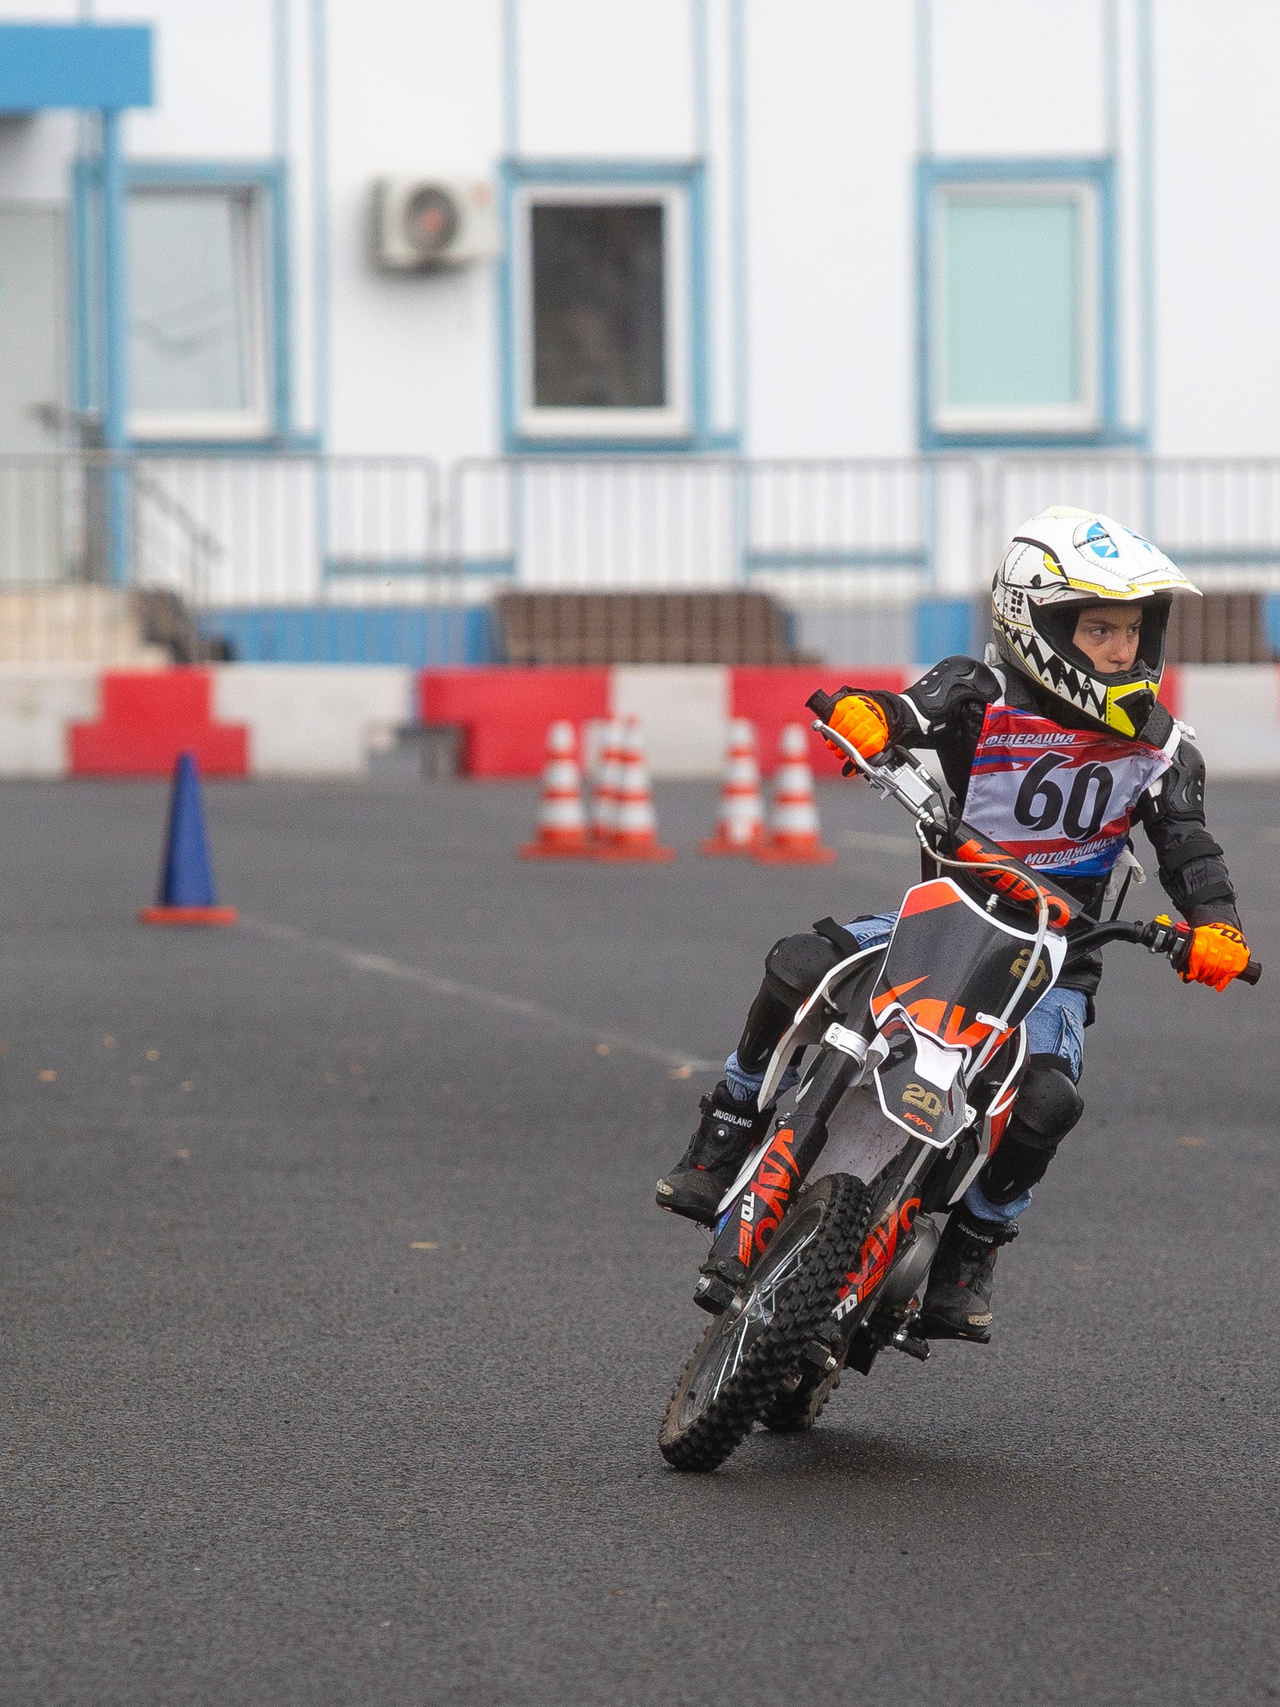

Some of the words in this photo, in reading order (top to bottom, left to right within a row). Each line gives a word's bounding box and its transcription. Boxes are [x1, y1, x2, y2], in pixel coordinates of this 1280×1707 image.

[985, 733, 1076, 747] ФЕДЕРАЦИЯ
[1014, 751, 1114, 841] 60
[1023, 830, 1126, 865] МОТОДЖИМ
[901, 1083, 942, 1117] 20
[713, 1109, 753, 1128] JIUGULANG
